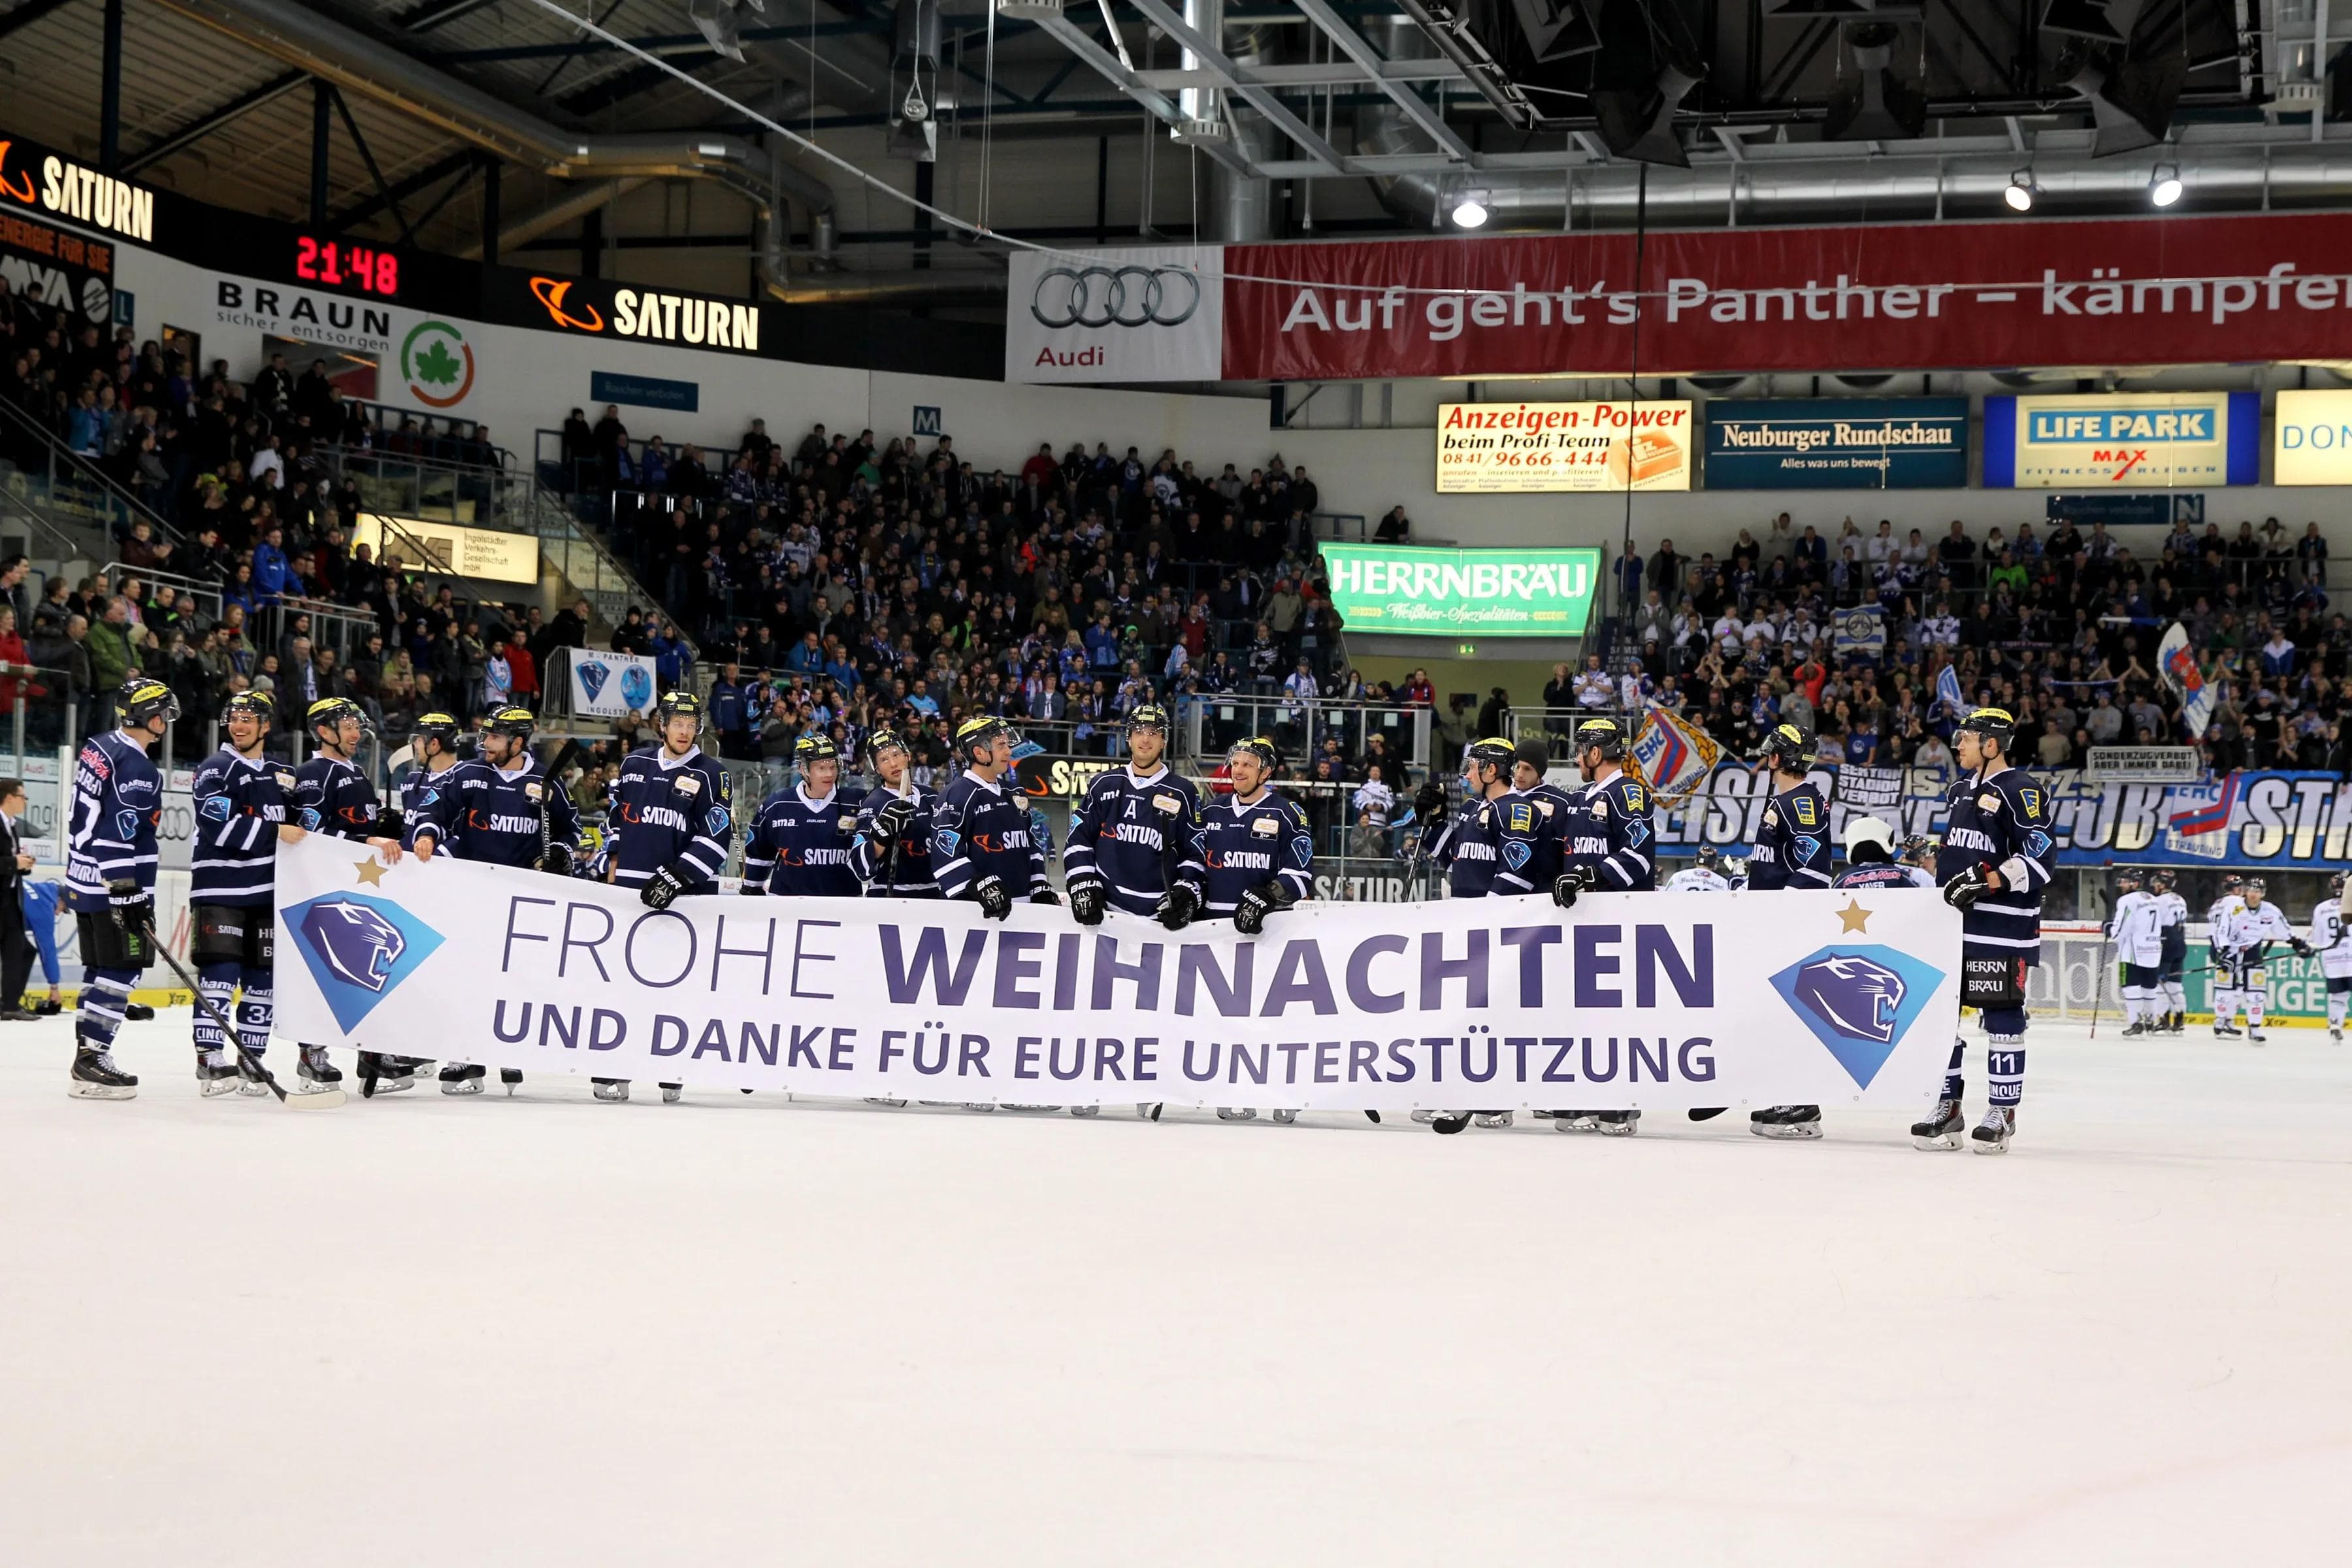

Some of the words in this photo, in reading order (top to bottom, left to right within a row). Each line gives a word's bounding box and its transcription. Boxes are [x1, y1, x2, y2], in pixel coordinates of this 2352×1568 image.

[42, 155, 154, 242] SATURN
[88, 243, 110, 273] SIE
[297, 236, 398, 295] 21:48
[120, 295, 129, 321] L
[218, 281, 389, 337] BRAUN
[1281, 286, 1405, 333] Auf
[1667, 274, 1953, 323] Panther
[217, 309, 278, 333] sicher
[291, 322, 391, 353] entsorgen
[613, 289, 759, 351] SATURN
[1036, 346, 1104, 367] Audi
[915, 409, 939, 433] M
[1445, 404, 1687, 436] Anzeigen-Power
[2036, 415, 2102, 439] LIFE
[2110, 413, 2206, 438] PARK
[1444, 433, 1495, 449] beim
[1501, 433, 1611, 449] Profi-Team
[1723, 423, 1831, 451] Neuburger
[1833, 422, 1952, 446] Rundschau
[1781, 458, 1805, 469] Alles
[1807, 459, 1828, 468] was
[1831, 459, 1849, 468] uns
[1851, 457, 1891, 471] bewegt
[2093, 449, 2148, 481] MAX
[2177, 498, 2201, 521] N
[465, 564, 482, 572] mbH
[1331, 559, 1587, 601] HERRNBRÄU
[603, 653, 640, 663] PANTHER
[586, 706, 629, 716] INGOLSTA
[1634, 728, 1665, 765] EHC
[24, 763, 45, 774] Audi
[2094, 760, 2119, 769] ABER
[2124, 760, 2157, 769] IMMER
[463, 779, 489, 790] ama
[1838, 776, 1902, 792] STADION
[1838, 788, 1900, 804] VERBOT
[1124, 800, 1137, 819] A
[772, 817, 795, 828] ama
[1947, 827, 1996, 854] SATURN
[1223, 851, 1271, 870] SATURN
[108, 891, 149, 906] BAUER
[1314, 875, 1426, 902] SATURN
[2149, 909, 2157, 932] 7
[501, 894, 841, 1000] FROHE
[877, 923, 1714, 1017] WEIHNACHTEN
[1966, 960, 2007, 973] HERRN
[1968, 979, 2003, 992] BRÄU
[201, 998, 231, 1017] 34
[492, 999, 627, 1052] UND
[650, 1013, 857, 1071] DANKE
[879, 1021, 991, 1078] FÜR
[1014, 1036, 1160, 1081] EURE
[1182, 1025, 1717, 1085] UNTERSTÜTZUNG
[1990, 1053, 2017, 1073] 11
